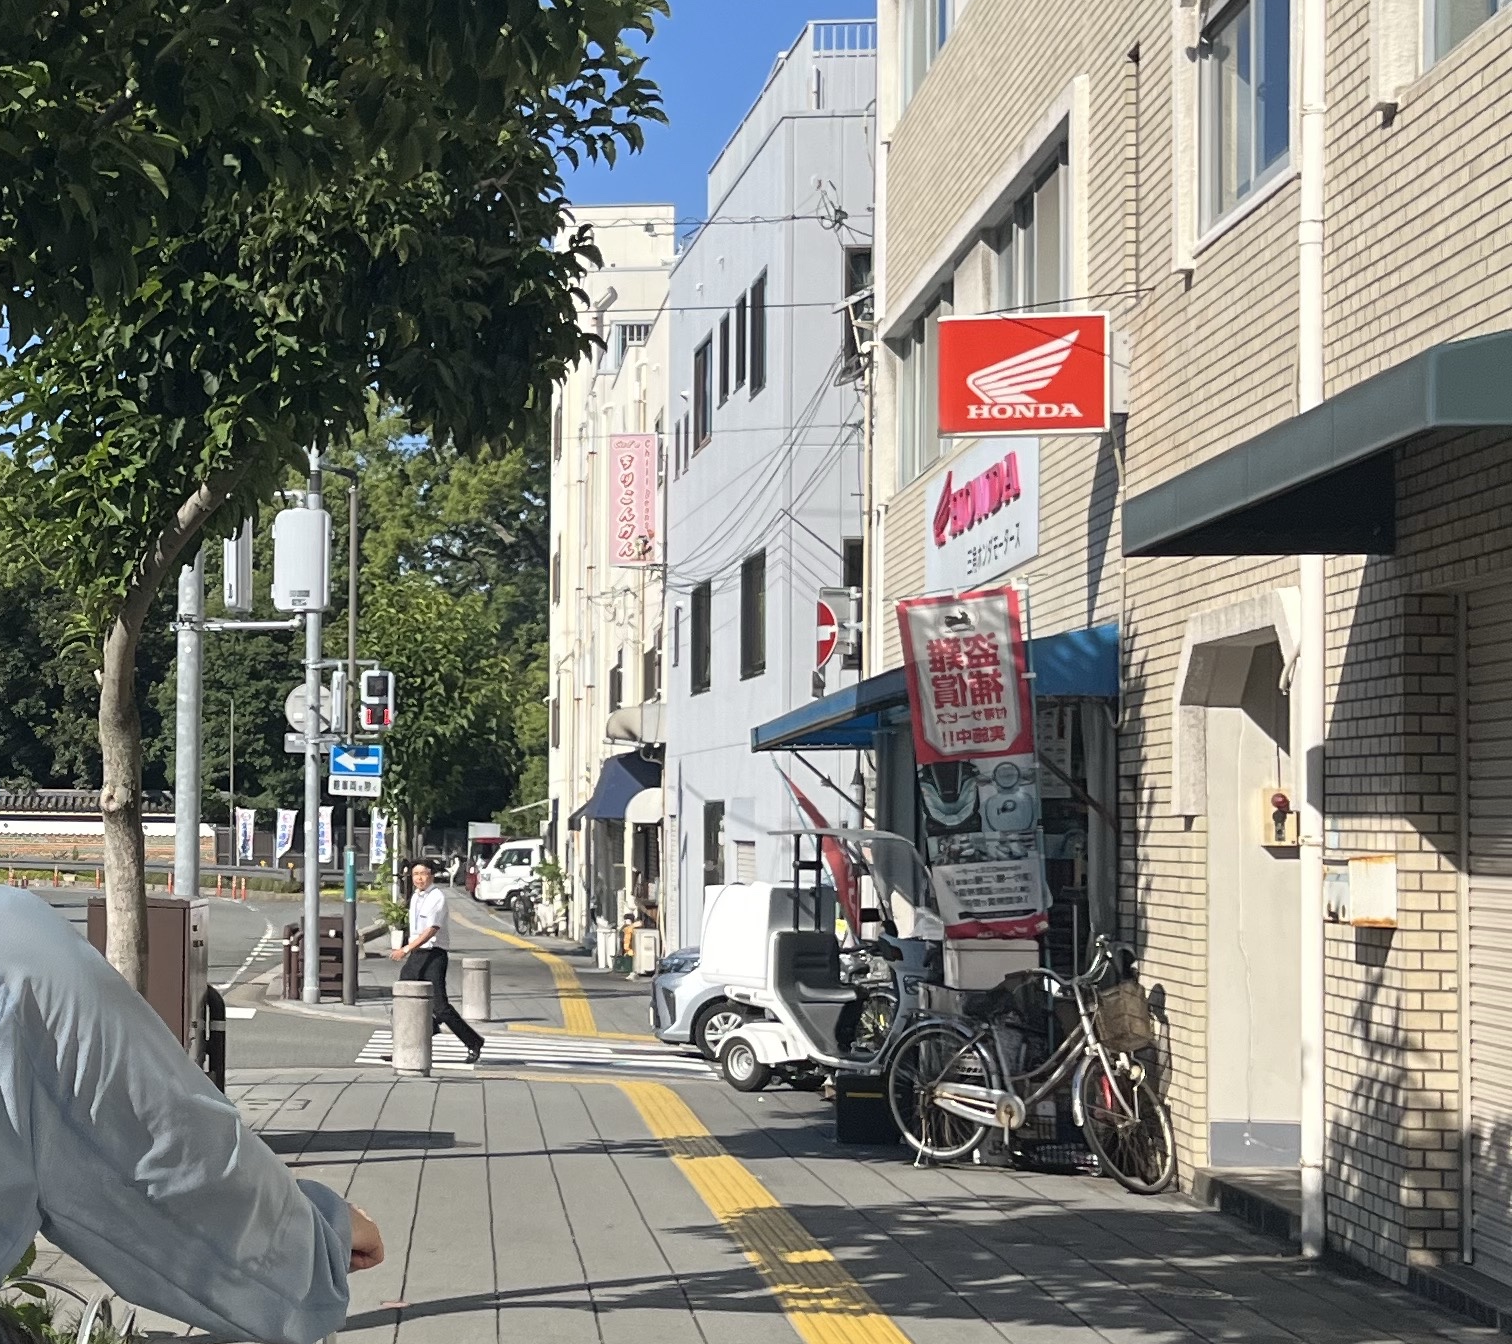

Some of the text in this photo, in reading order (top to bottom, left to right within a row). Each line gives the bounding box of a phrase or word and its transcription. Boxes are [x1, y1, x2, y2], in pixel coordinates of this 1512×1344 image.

[967, 403, 1083, 418] HONDA
[618, 454, 636, 557] ちりこんかん
